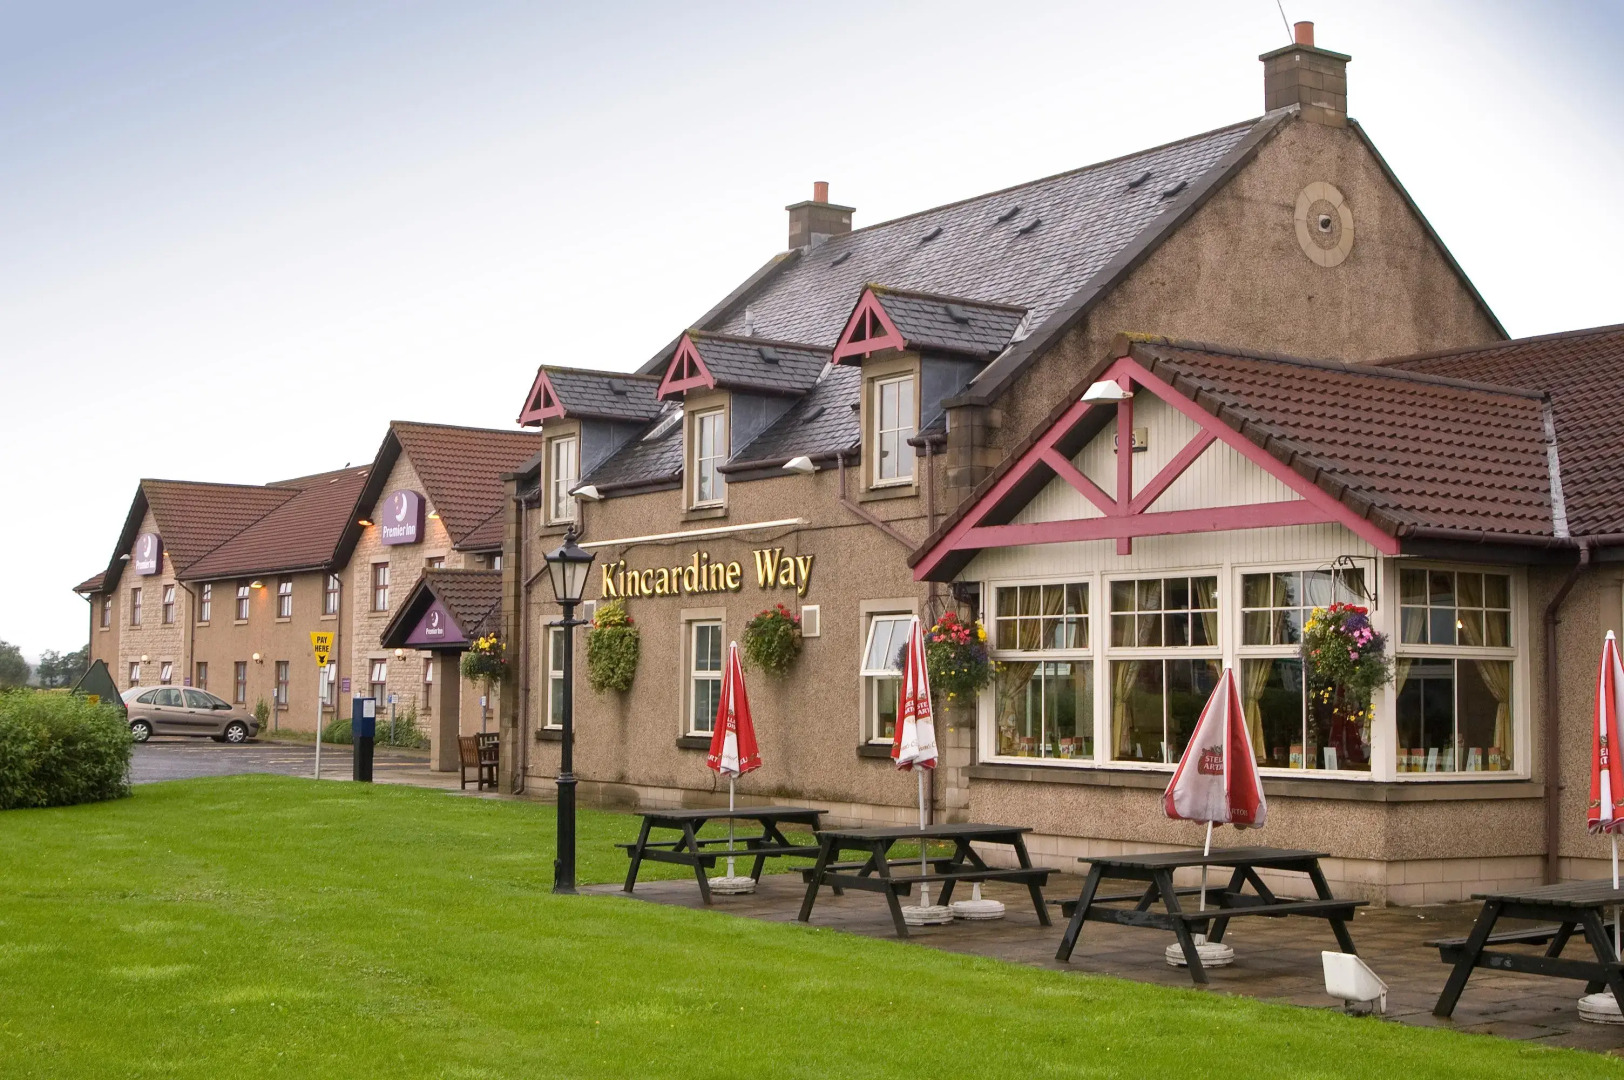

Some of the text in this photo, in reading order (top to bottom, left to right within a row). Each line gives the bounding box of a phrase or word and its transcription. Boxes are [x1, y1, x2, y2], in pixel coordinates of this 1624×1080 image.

[383, 523, 416, 538] Premier Inn
[600, 547, 814, 598] Kincardine Way
[316, 636, 328, 644] PAY
[314, 645, 329, 653] HERE
